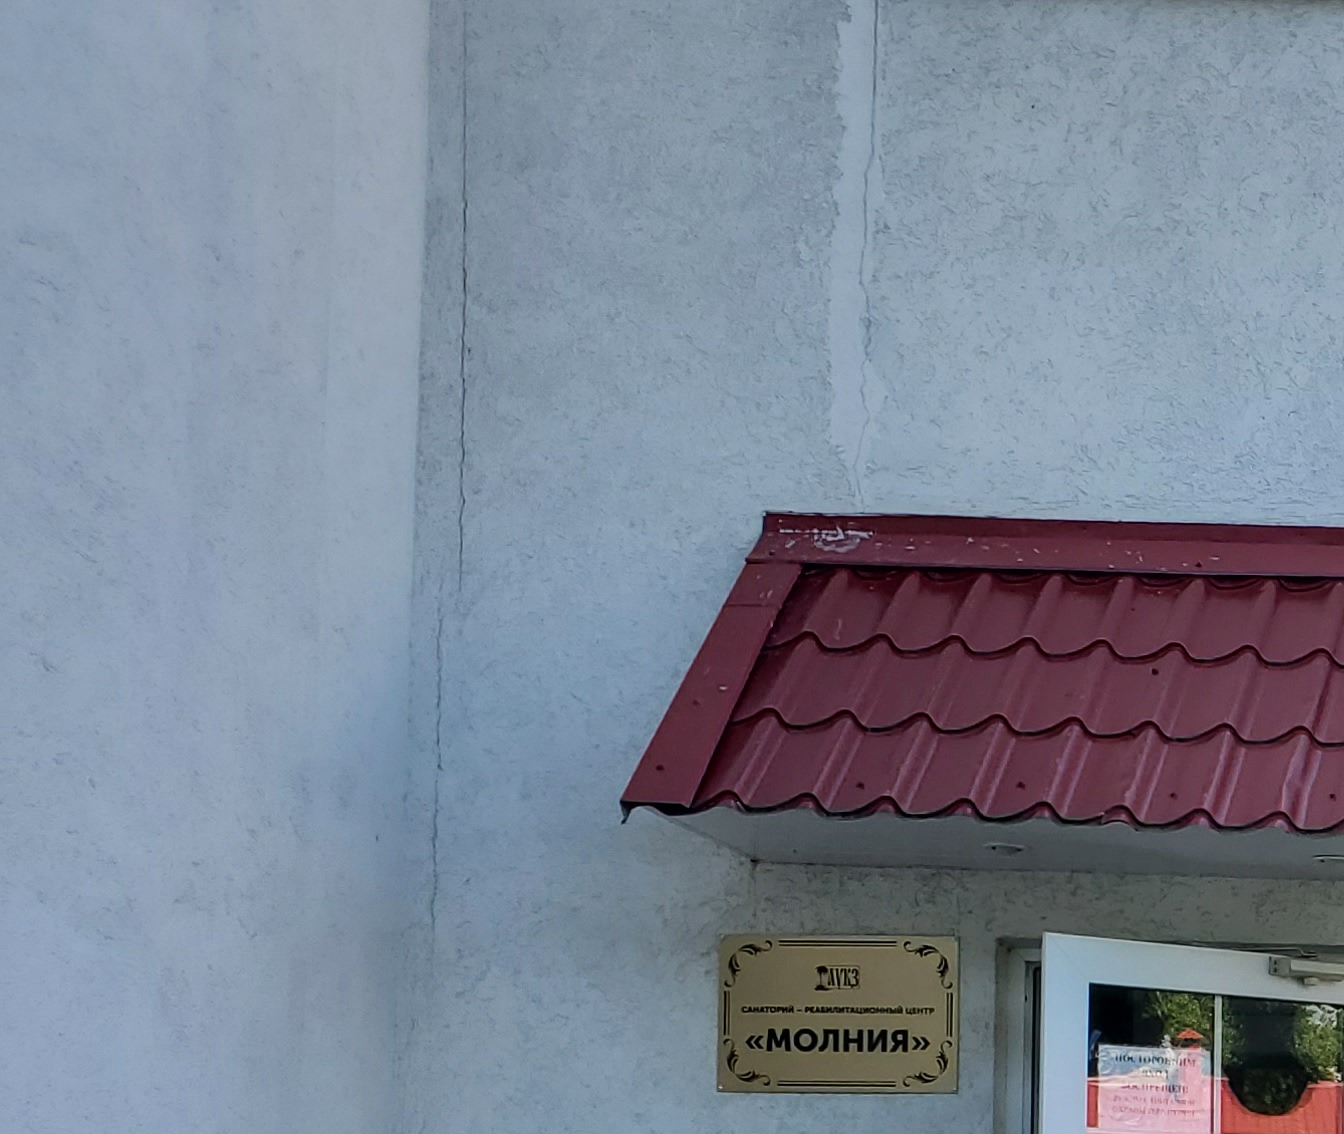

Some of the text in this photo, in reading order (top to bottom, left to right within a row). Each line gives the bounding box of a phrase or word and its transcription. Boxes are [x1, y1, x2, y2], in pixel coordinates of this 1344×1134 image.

[741, 1005, 795, 1015] САНАТОРИЙ
[804, 1005, 904, 1016] РЕАБИЛИТАЦИОННЫЙ
[905, 1007, 936, 1016] ЦЕНТР
[745, 1027, 931, 1053] «МОЛНИЯ»
